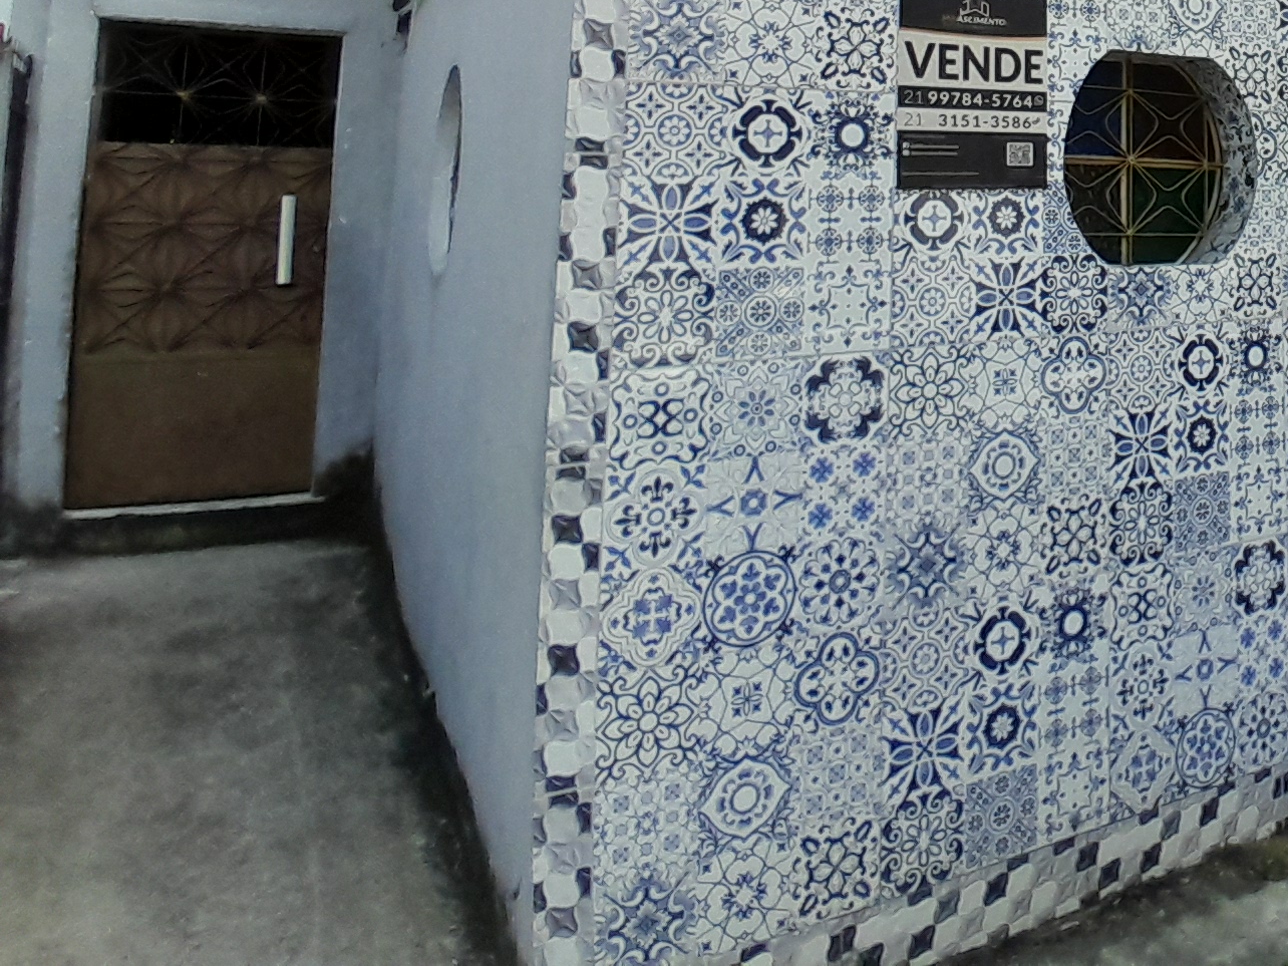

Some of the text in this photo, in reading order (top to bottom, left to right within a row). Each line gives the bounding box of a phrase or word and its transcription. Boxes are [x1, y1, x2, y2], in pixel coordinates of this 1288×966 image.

[904, 40, 1044, 85] VENDE
[904, 89, 1033, 108] 21 99784-5764
[904, 112, 1032, 128] 21 3151-3586
